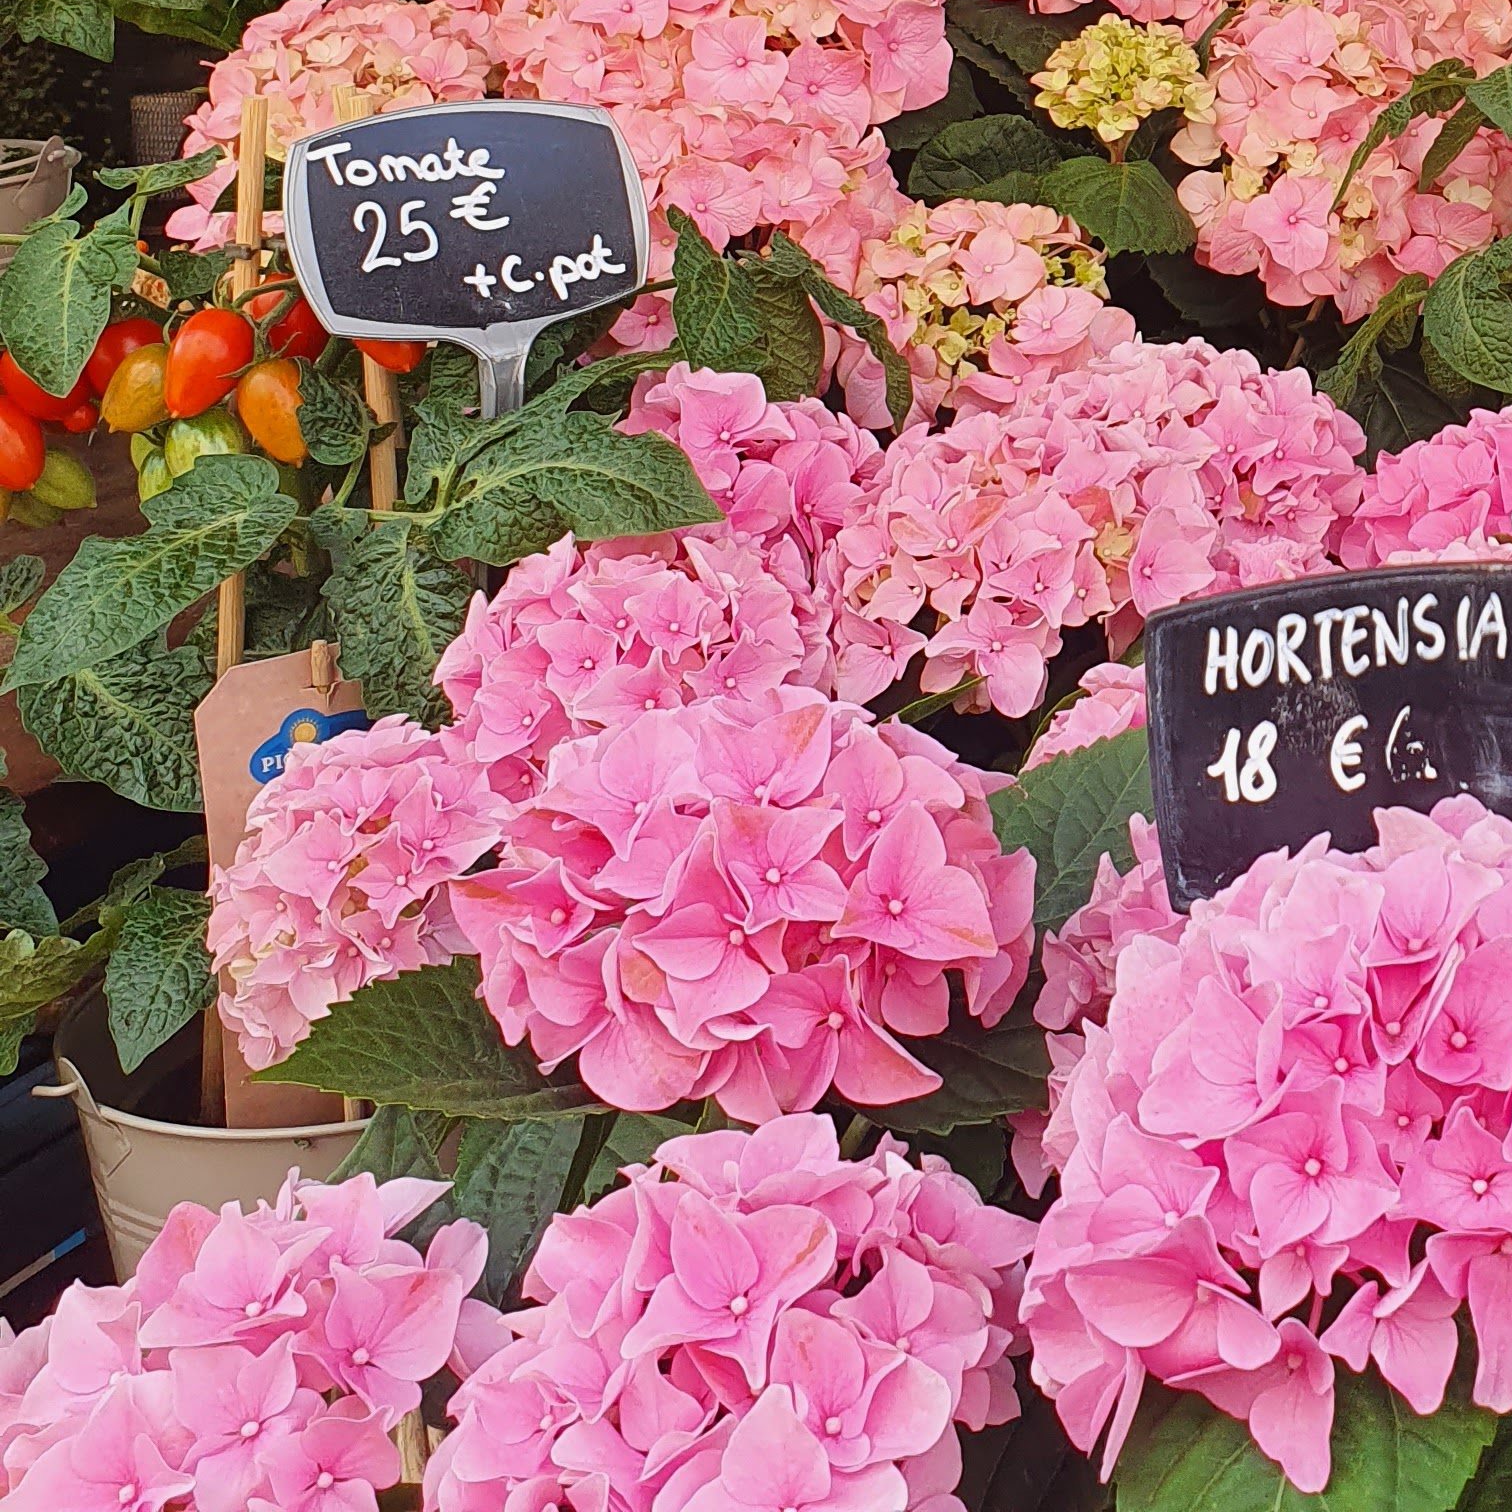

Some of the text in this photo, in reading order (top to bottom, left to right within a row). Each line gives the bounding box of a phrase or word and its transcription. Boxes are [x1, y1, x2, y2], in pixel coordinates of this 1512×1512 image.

[306, 137, 505, 186] Tomate
[1204, 591, 1507, 695] HORTENSIA
[1207, 720, 1278, 802] 18
